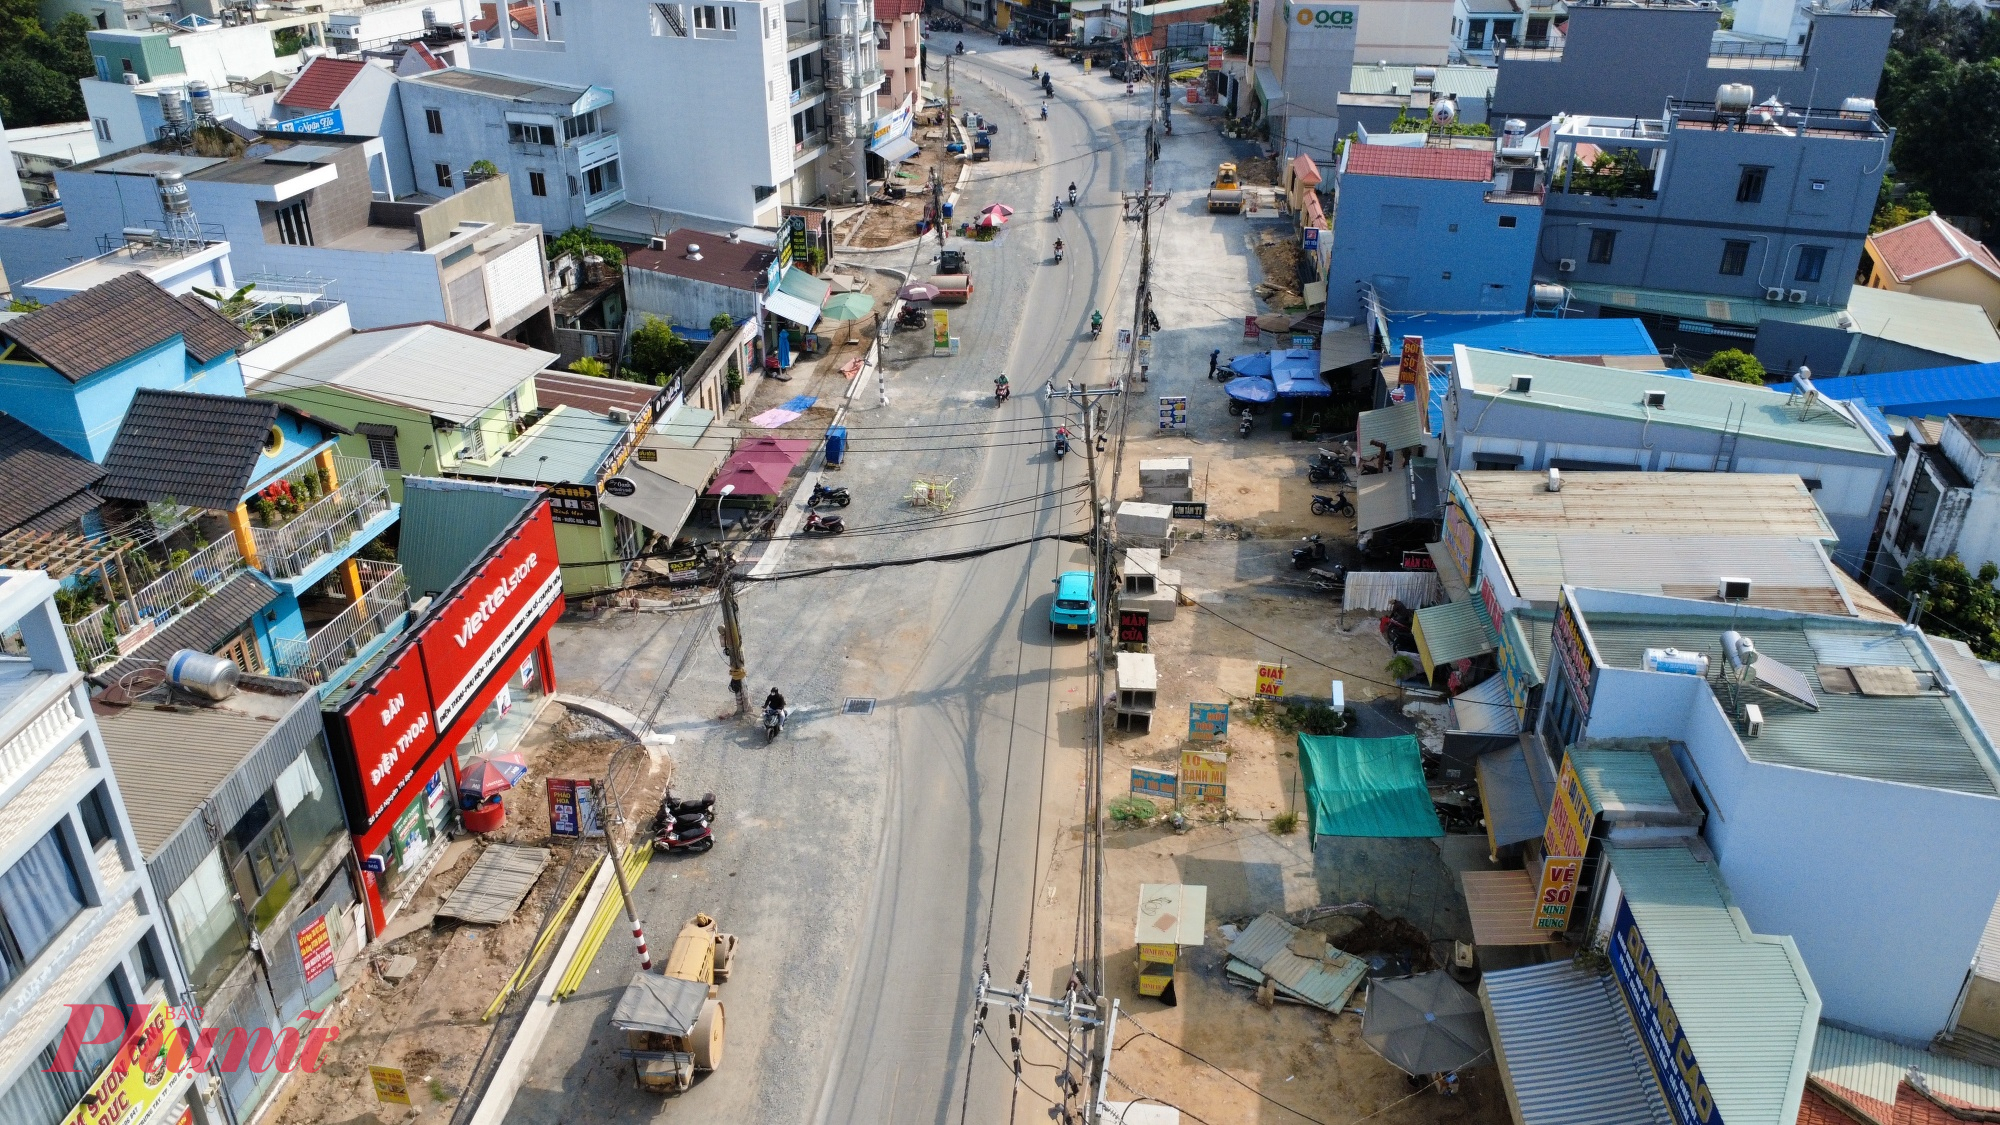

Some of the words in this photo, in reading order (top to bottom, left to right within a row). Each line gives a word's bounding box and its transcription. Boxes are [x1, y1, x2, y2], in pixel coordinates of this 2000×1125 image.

[1315, 10, 1354, 24] OCB
[1122, 614, 1147, 626] MÀN
[381, 692, 405, 727] BÁN
[370, 747, 398, 786] ĐIỆN
[397, 711, 429, 753] THOẠI
[1550, 862, 1576, 882] VÉ
[1543, 883, 1573, 903] SỐ
[1541, 905, 1567, 914] MINH
[1537, 915, 1564, 928] HÙNG
